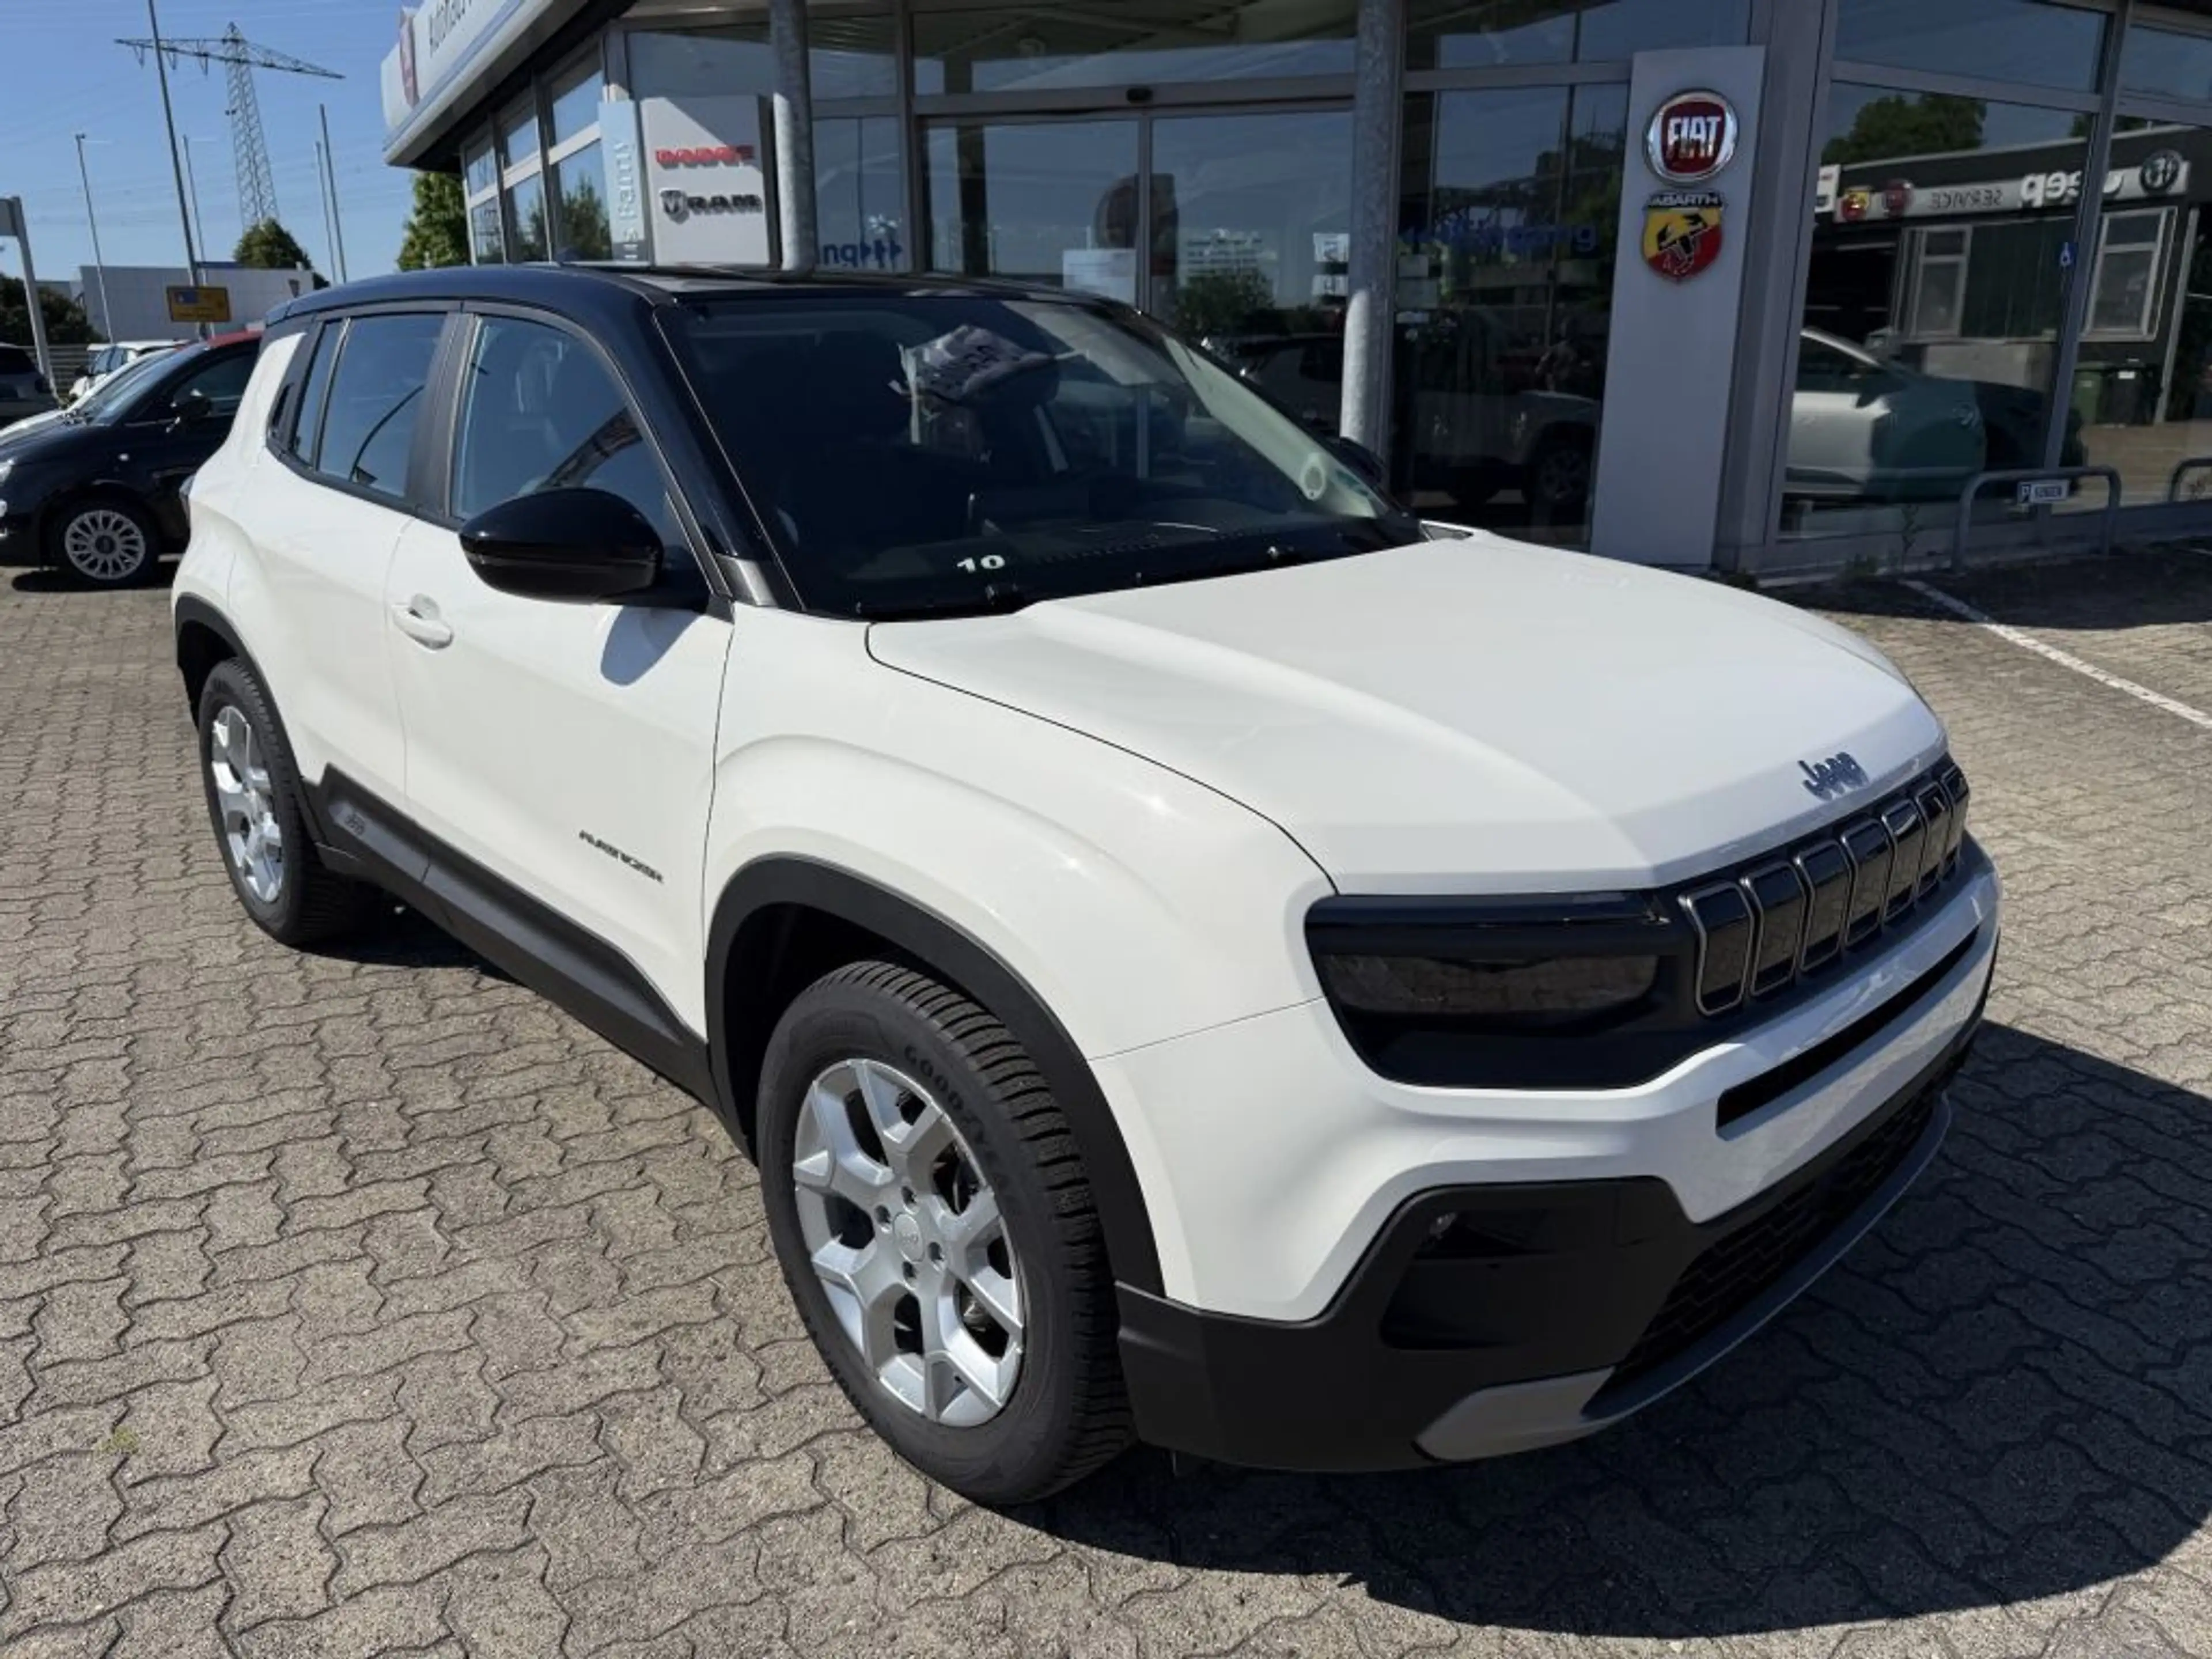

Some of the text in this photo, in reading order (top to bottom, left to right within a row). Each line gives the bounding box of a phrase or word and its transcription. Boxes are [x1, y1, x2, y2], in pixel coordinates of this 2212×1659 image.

[1666, 116, 1722, 158] FIAT
[1652, 191, 1718, 206] ABARTH
[956, 555, 1005, 573] 10
